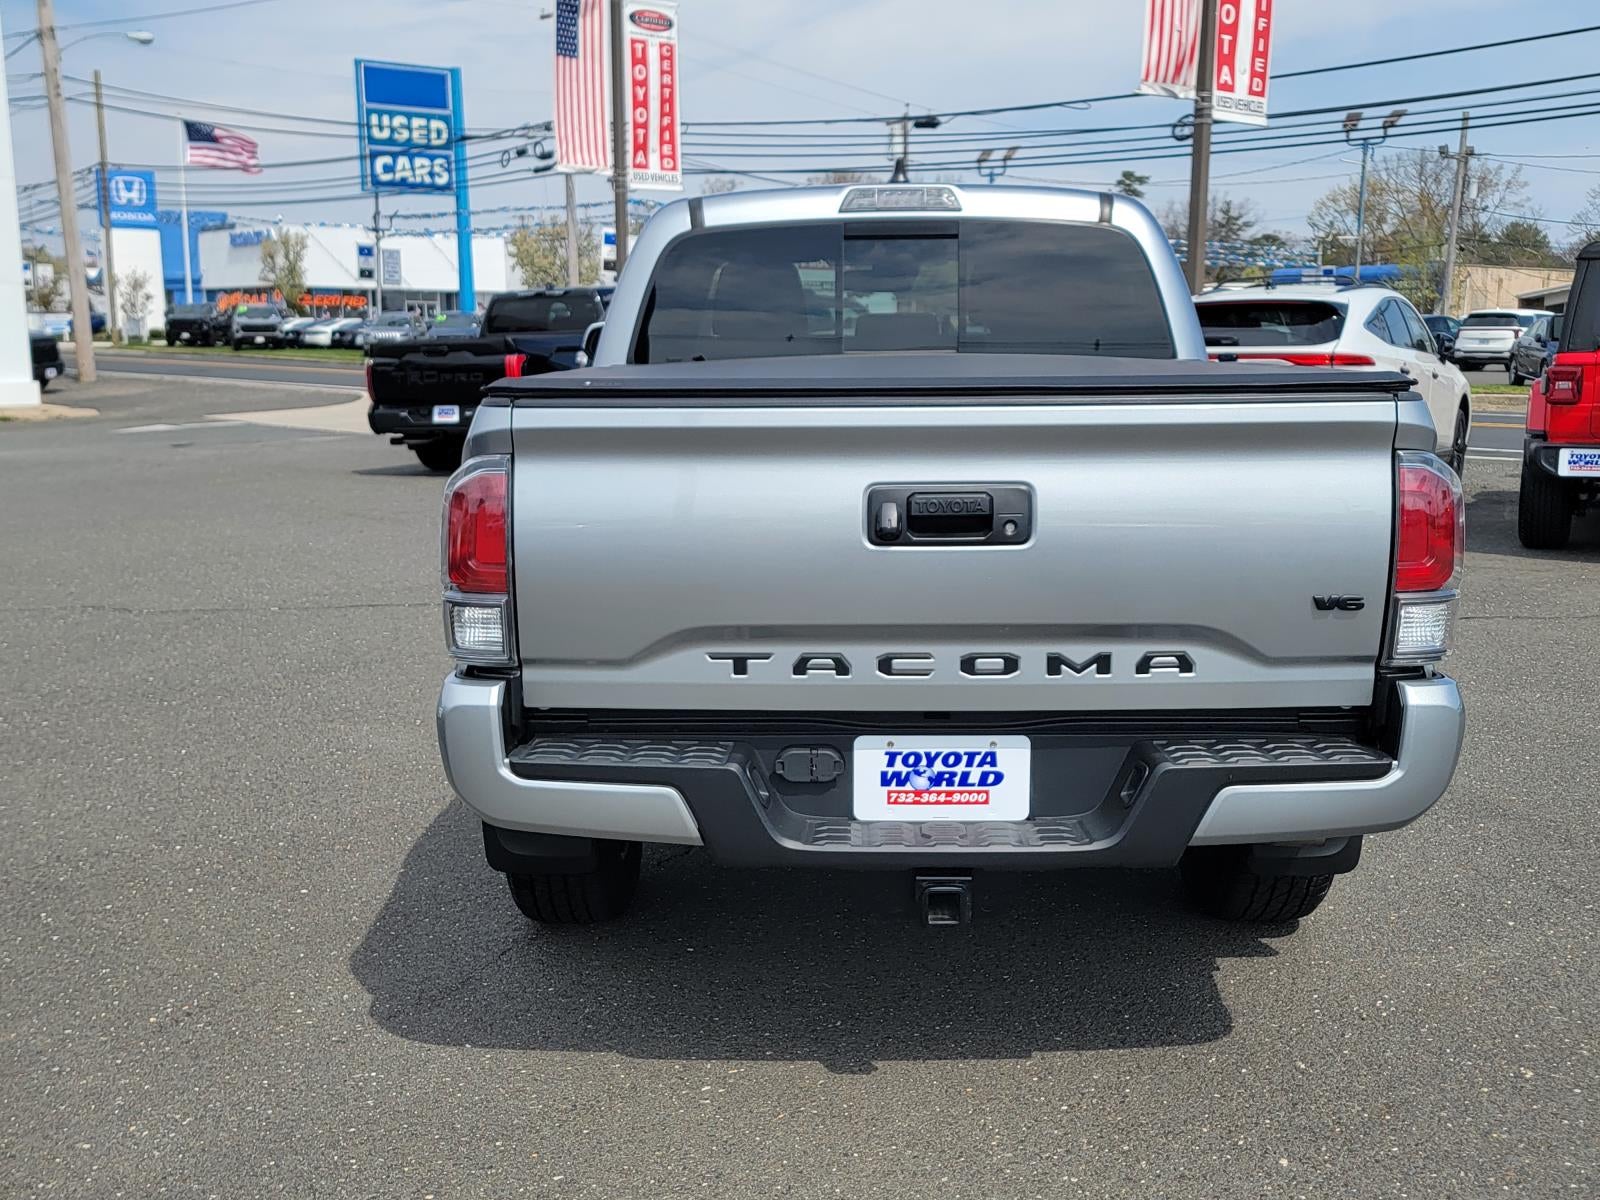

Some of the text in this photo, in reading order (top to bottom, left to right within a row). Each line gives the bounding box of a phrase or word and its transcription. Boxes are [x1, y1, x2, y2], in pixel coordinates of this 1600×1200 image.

[633, 42, 648, 165] TOYOTA
[662, 46, 674, 167] CERTIFIED
[370, 113, 448, 146] USED
[374, 155, 450, 186] CARS
[634, 172, 679, 183] USED VEHICLES
[914, 499, 986, 513] TOYOTA
[1312, 594, 1366, 612] V6
[705, 652, 1196, 679] TACOMA
[884, 751, 998, 768] TOYOTA
[889, 792, 987, 803] 732-364-9000
